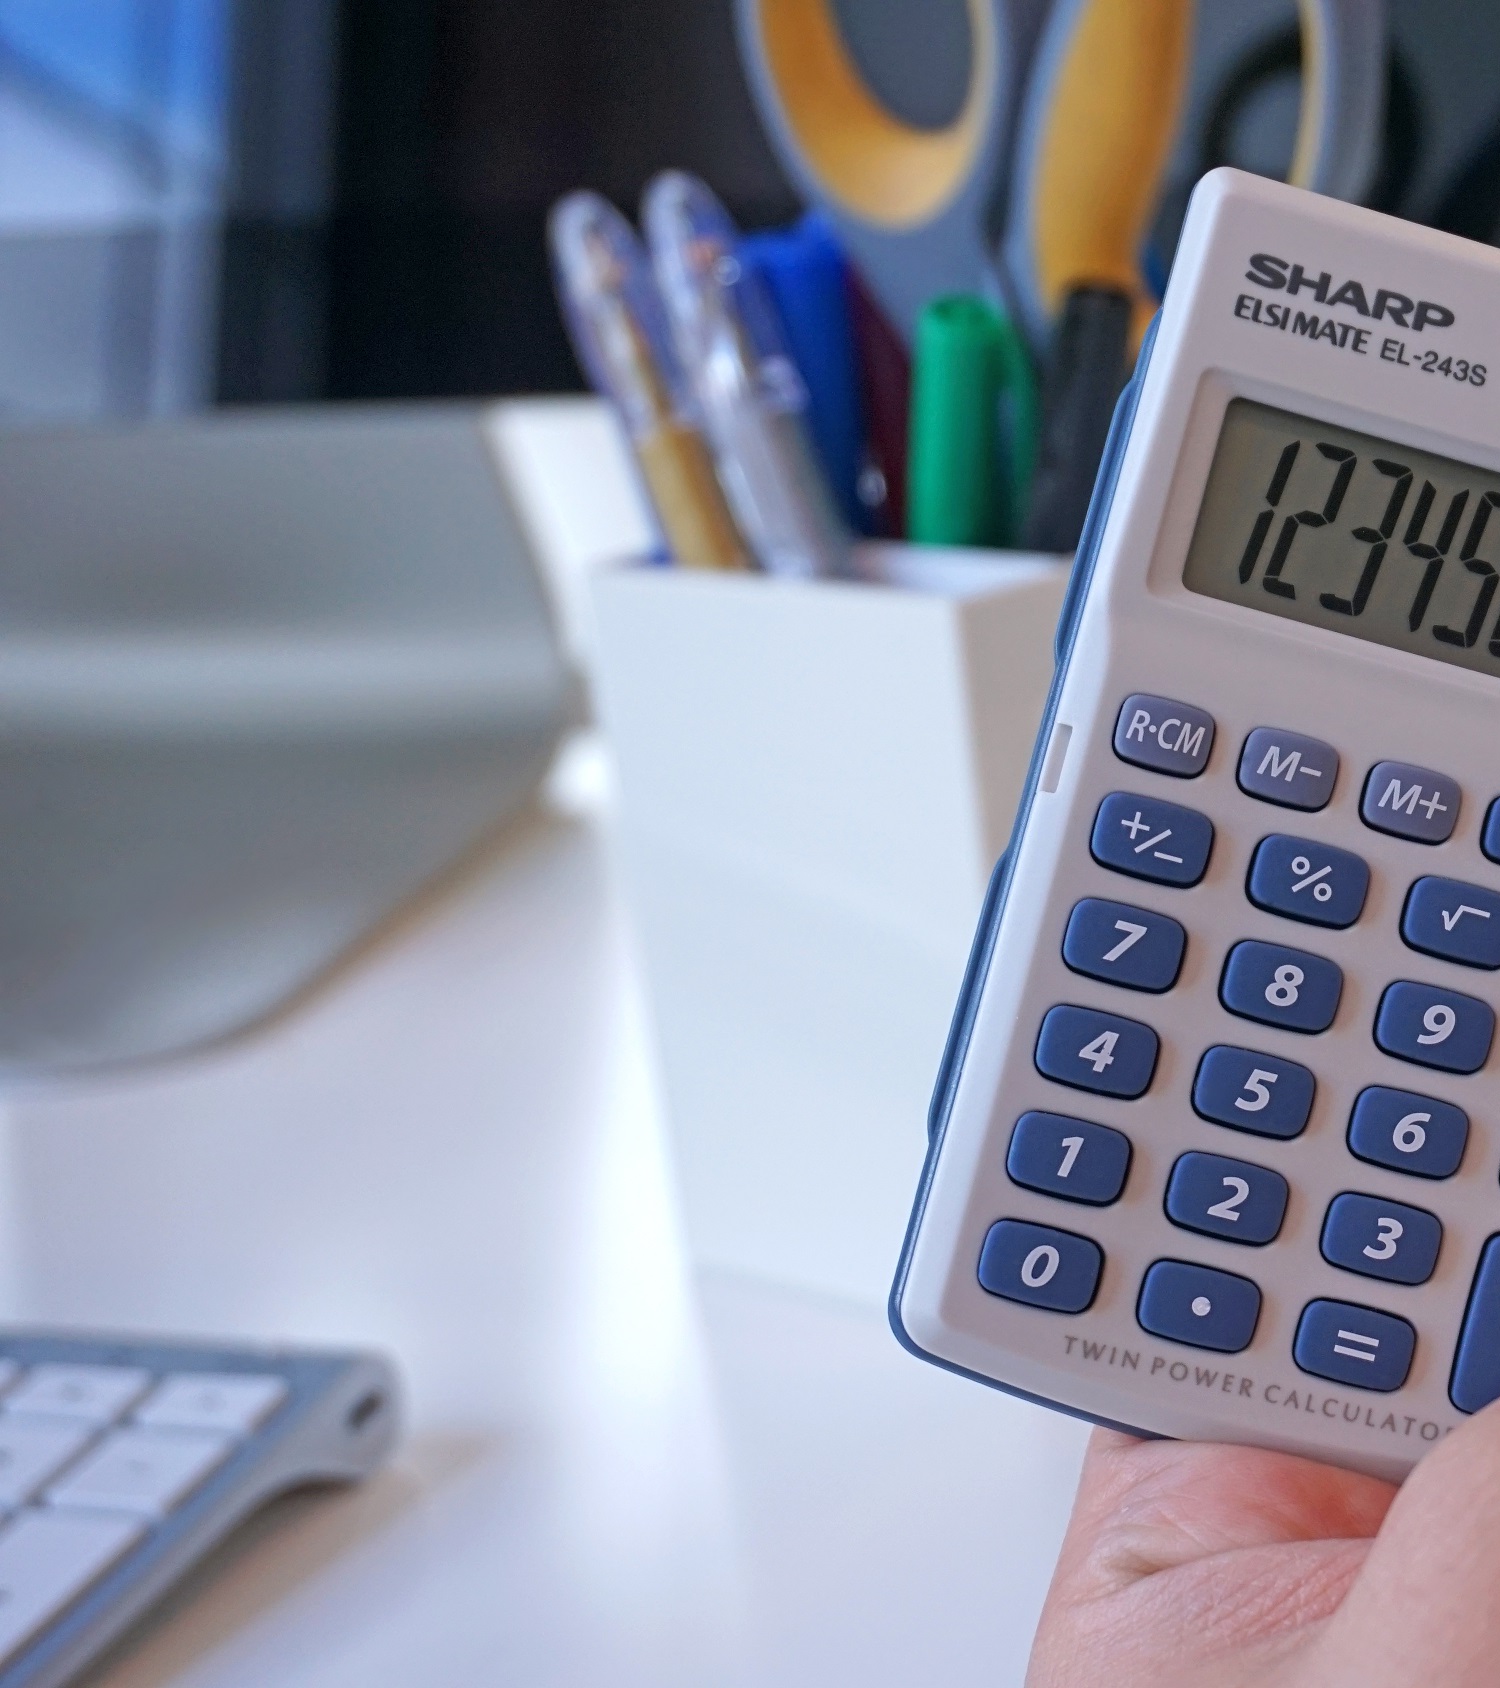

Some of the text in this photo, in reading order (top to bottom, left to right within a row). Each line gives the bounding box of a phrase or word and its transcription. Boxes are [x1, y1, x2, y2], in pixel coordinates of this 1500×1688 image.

[1245, 253, 1455, 331] SHARP
[1380, 338, 1487, 386] EL-243S
[1378, 776, 1447, 821] M+
[1291, 856, 1333, 902] %
[1102, 919, 1148, 962] 7
[1264, 964, 1305, 1007] 8
[1416, 1004, 1456, 1045] 9
[1078, 1030, 1120, 1073] 4
[1234, 1068, 1279, 1112] 5
[1392, 1112, 1432, 1153] 6
[1056, 1136, 1085, 1178] 1
[1206, 1176, 1250, 1222] 2
[1362, 1217, 1404, 1260] 3
[1020, 1244, 1060, 1288] 0
[1333, 1329, 1380, 1362] =
[1064, 1335, 1455, 1441] TWIN POWER CALCULATO
